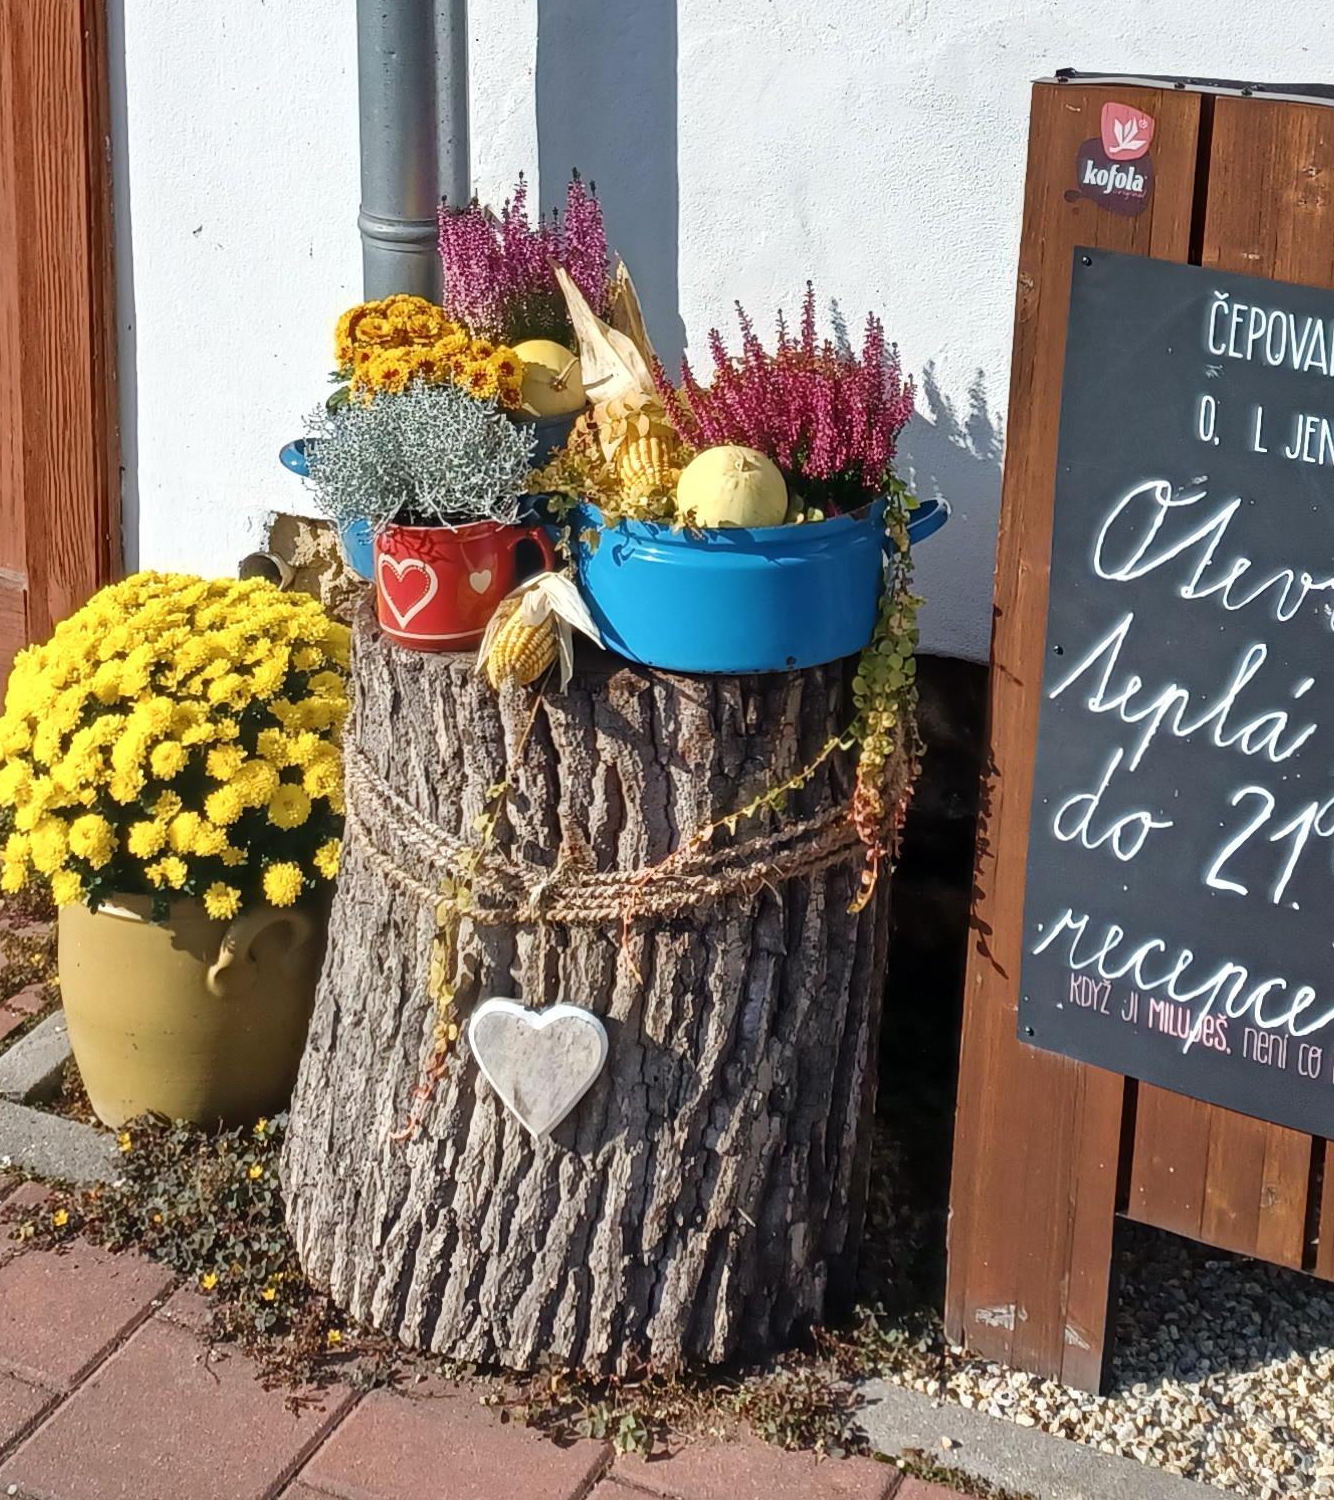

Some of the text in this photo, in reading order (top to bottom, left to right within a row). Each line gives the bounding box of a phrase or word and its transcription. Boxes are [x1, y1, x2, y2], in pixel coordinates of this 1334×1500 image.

[1083, 160, 1145, 194] kofola
[1253, 405, 1268, 453] L
[1052, 748, 1173, 861] do
[1070, 972, 1110, 1015] KDYŽ
